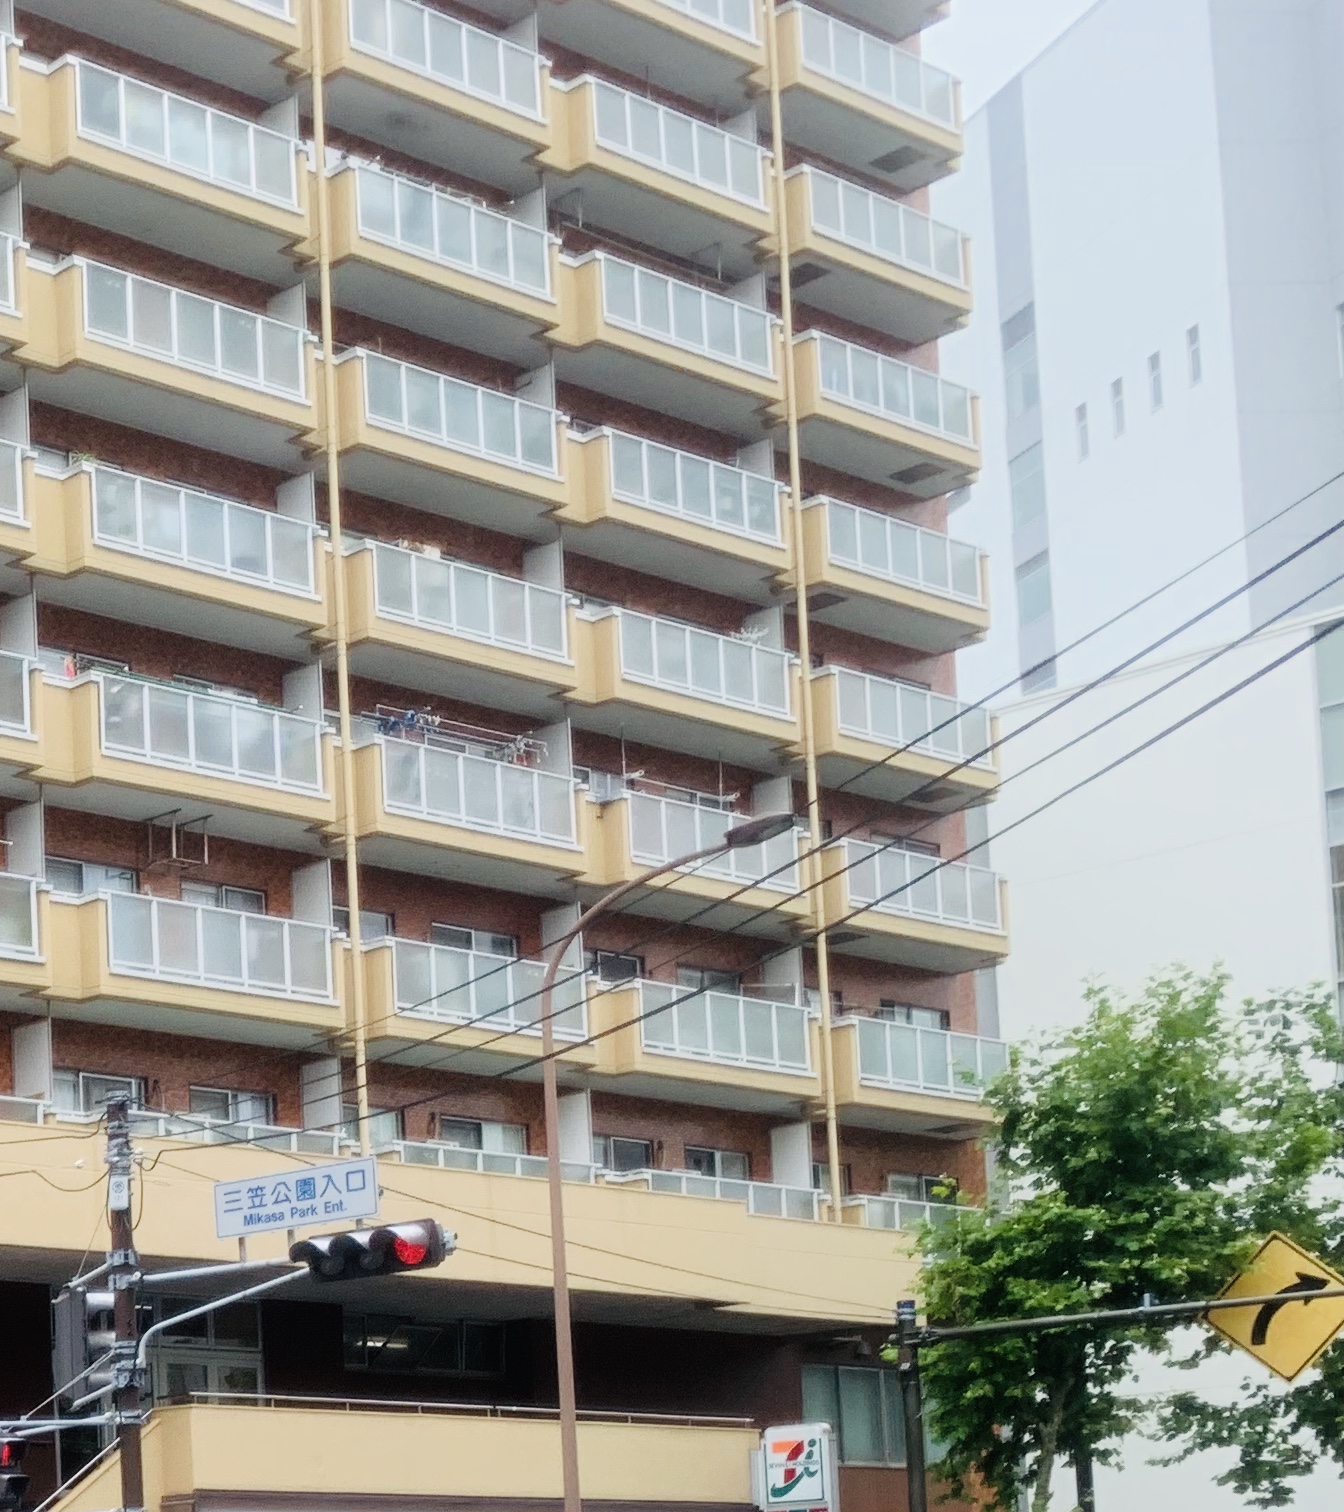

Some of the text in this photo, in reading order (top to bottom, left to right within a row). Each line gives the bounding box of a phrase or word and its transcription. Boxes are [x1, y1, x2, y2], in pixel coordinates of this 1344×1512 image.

[223, 1169, 366, 1213] 三笠公園入口
[243, 1201, 348, 1227] Mikasa Park Ent.
